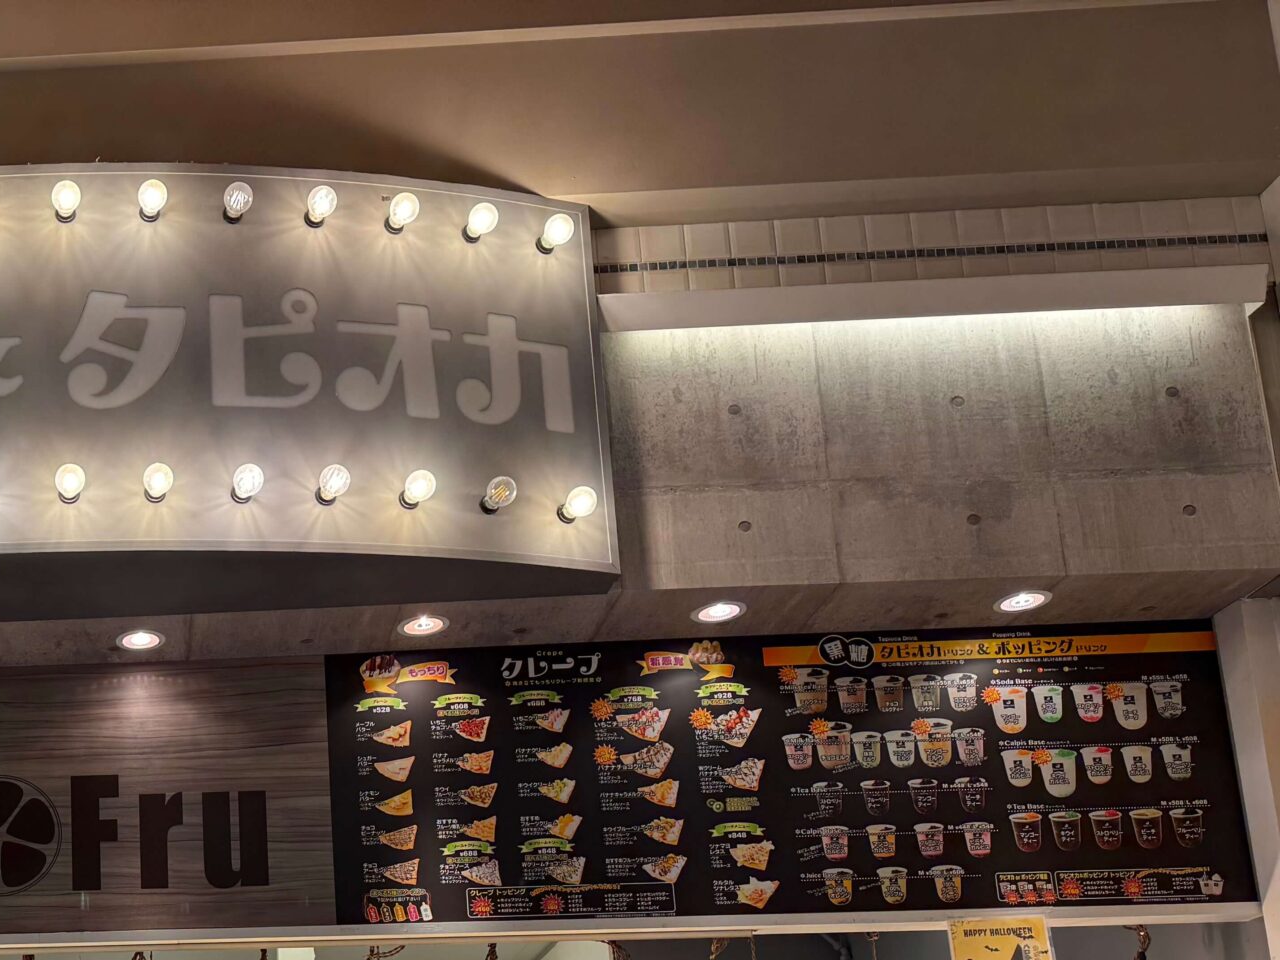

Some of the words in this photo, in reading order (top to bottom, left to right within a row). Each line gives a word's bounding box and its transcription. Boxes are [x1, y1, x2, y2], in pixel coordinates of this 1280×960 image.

[60, 287, 575, 432] タピオカ
[408, 664, 445, 677] もっちり
[501, 652, 601, 679] クレープ
[71, 774, 269, 891] Fru
[963, 929, 987, 937] HAPPY
[990, 927, 1032, 937] HALLOWEEN
